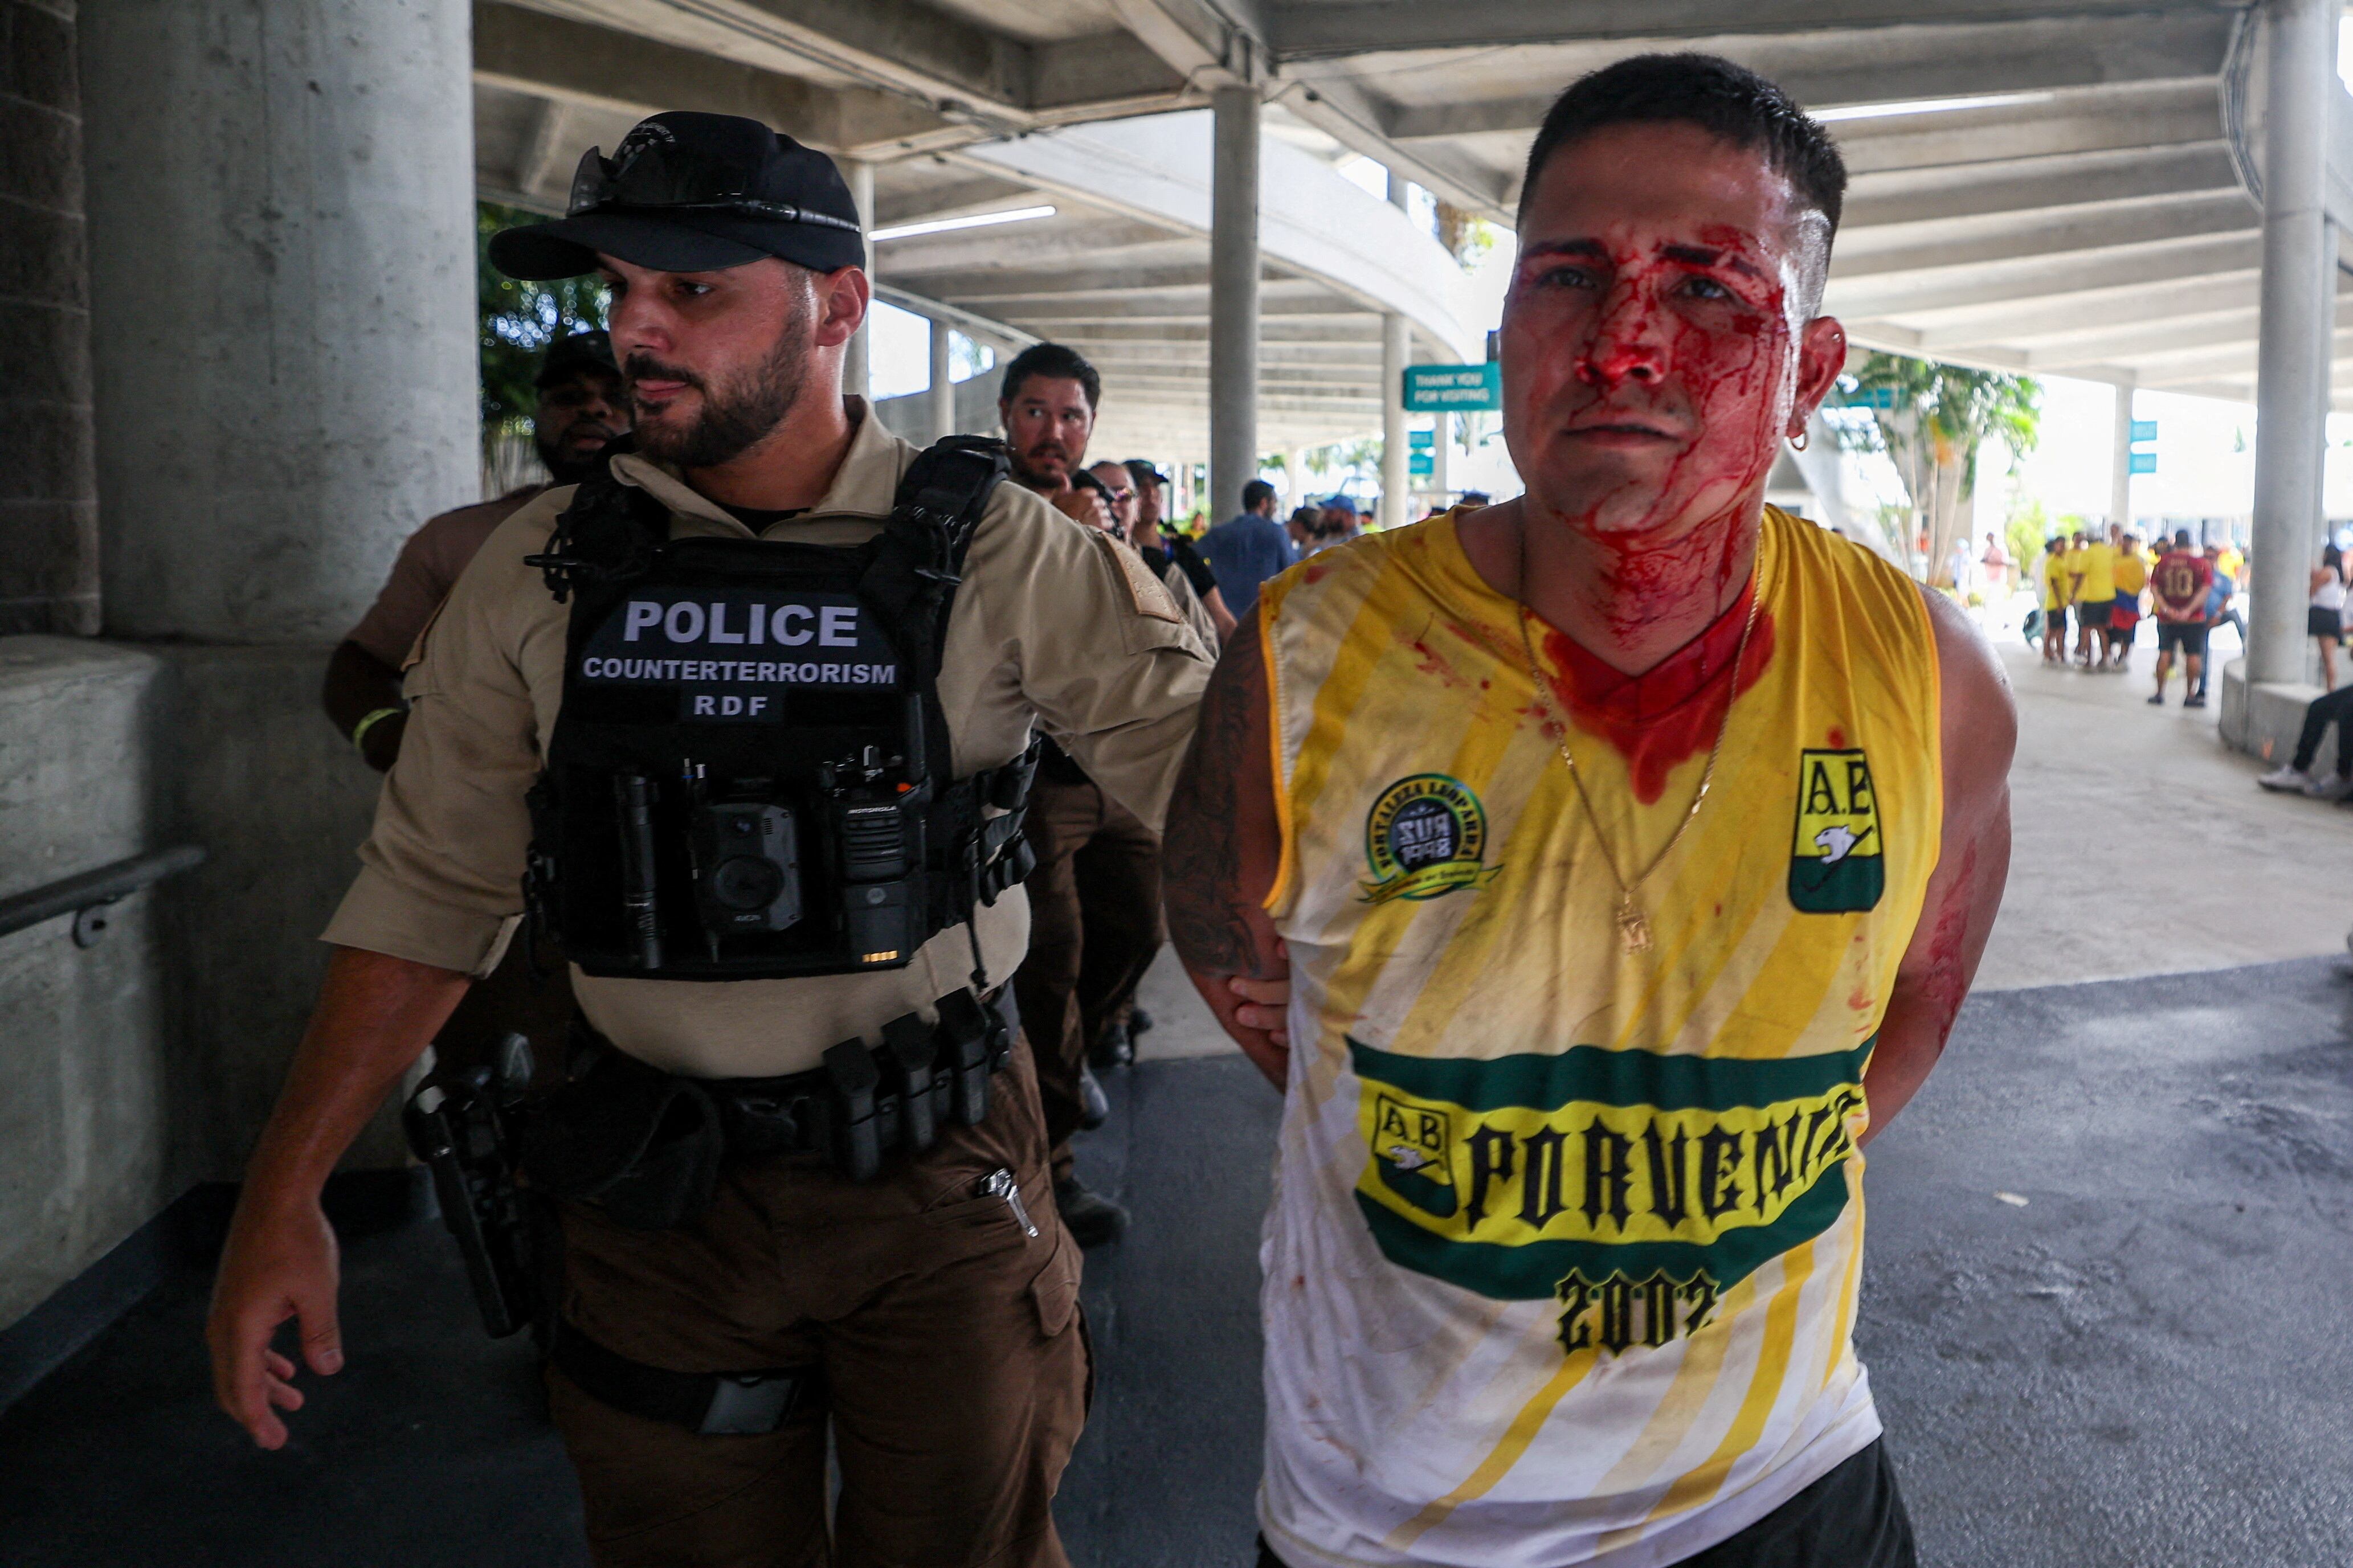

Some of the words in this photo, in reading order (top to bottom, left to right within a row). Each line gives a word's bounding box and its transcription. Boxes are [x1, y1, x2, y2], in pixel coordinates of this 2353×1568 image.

[1415, 374, 1454, 387] THANK
[1457, 372, 1483, 386] YOU
[1414, 390, 1438, 403] FOR
[1440, 388, 1490, 403] VISITING
[2165, 568, 2193, 597] 10
[623, 601, 859, 647] POLICE
[583, 657, 896, 685] COUNTERTERRORISM
[1397, 812, 1451, 845] SUR
[1400, 838, 1452, 866] 1998
[1554, 1266, 1721, 1357] 2002
